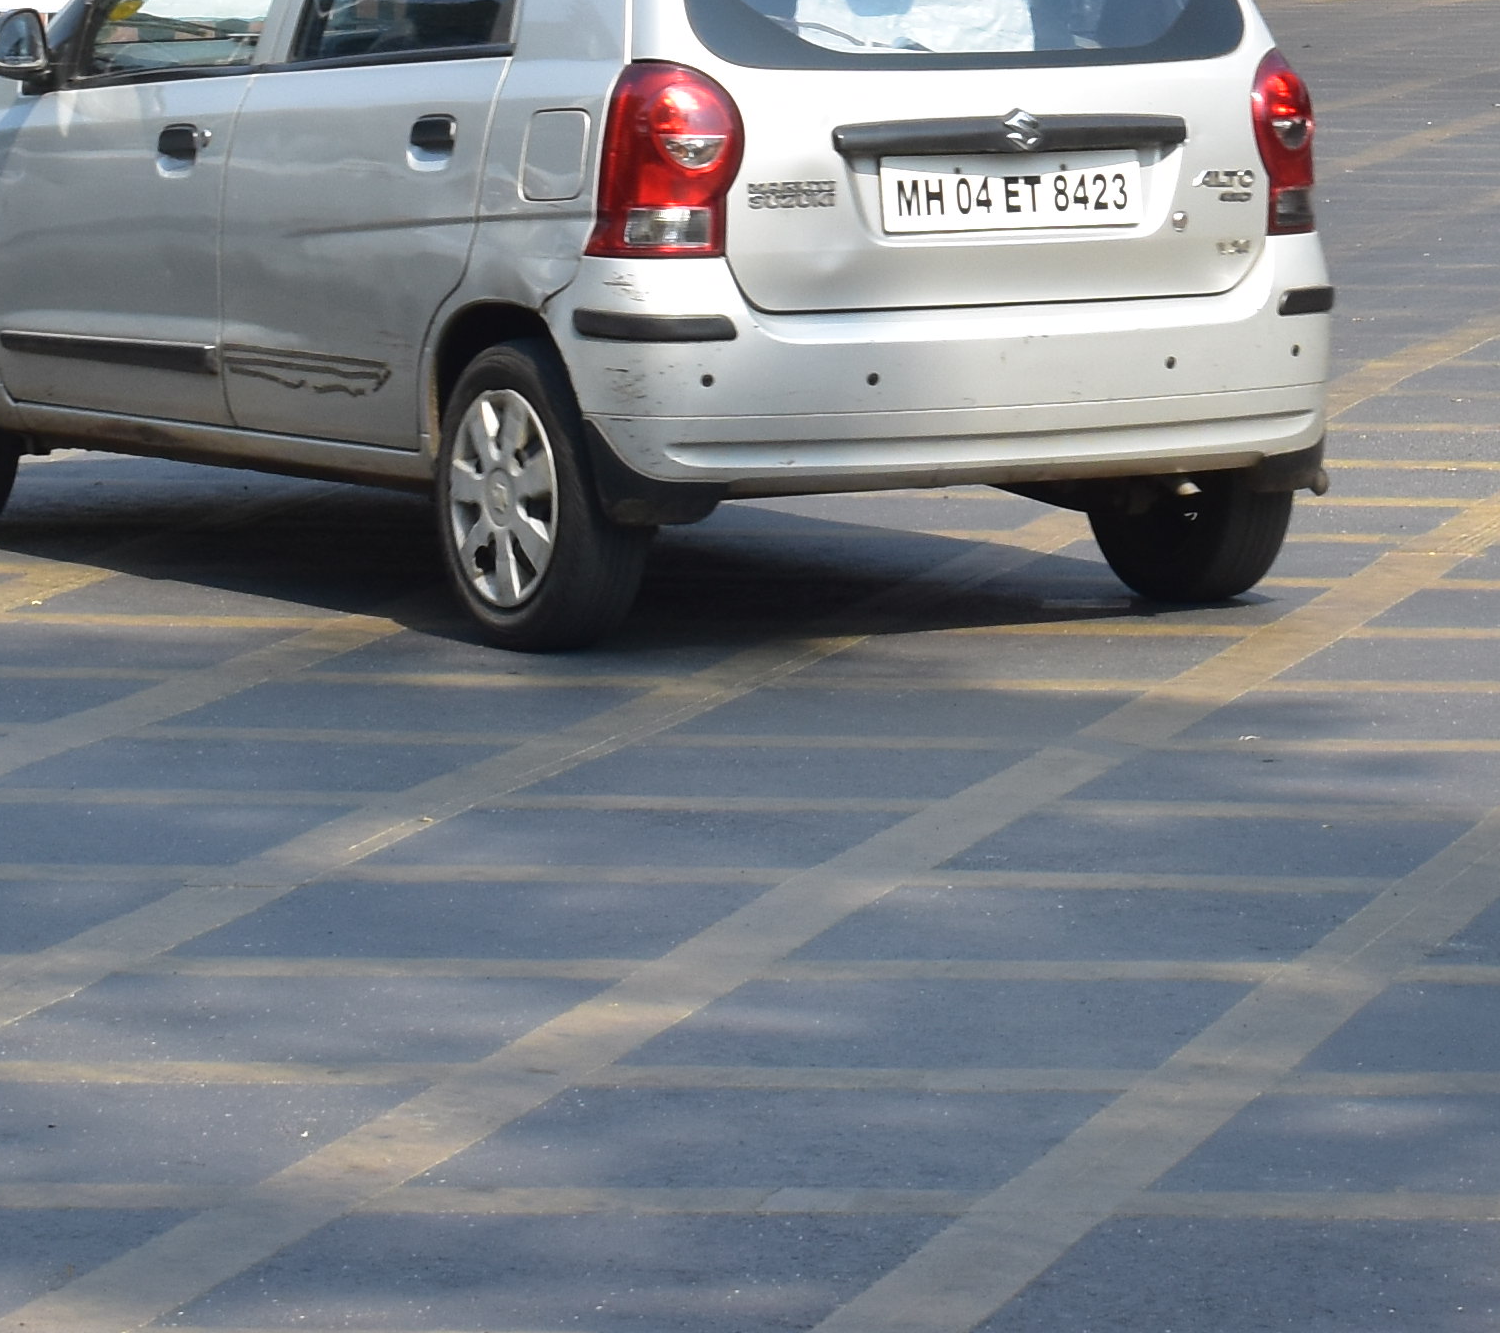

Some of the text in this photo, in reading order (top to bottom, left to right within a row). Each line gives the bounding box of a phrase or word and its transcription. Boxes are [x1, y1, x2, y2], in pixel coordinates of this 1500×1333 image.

[1192, 169, 1255, 188] ALTO
[747, 193, 836, 210] SUZUKI
[897, 171, 1130, 218] MH 04 ET 8423
